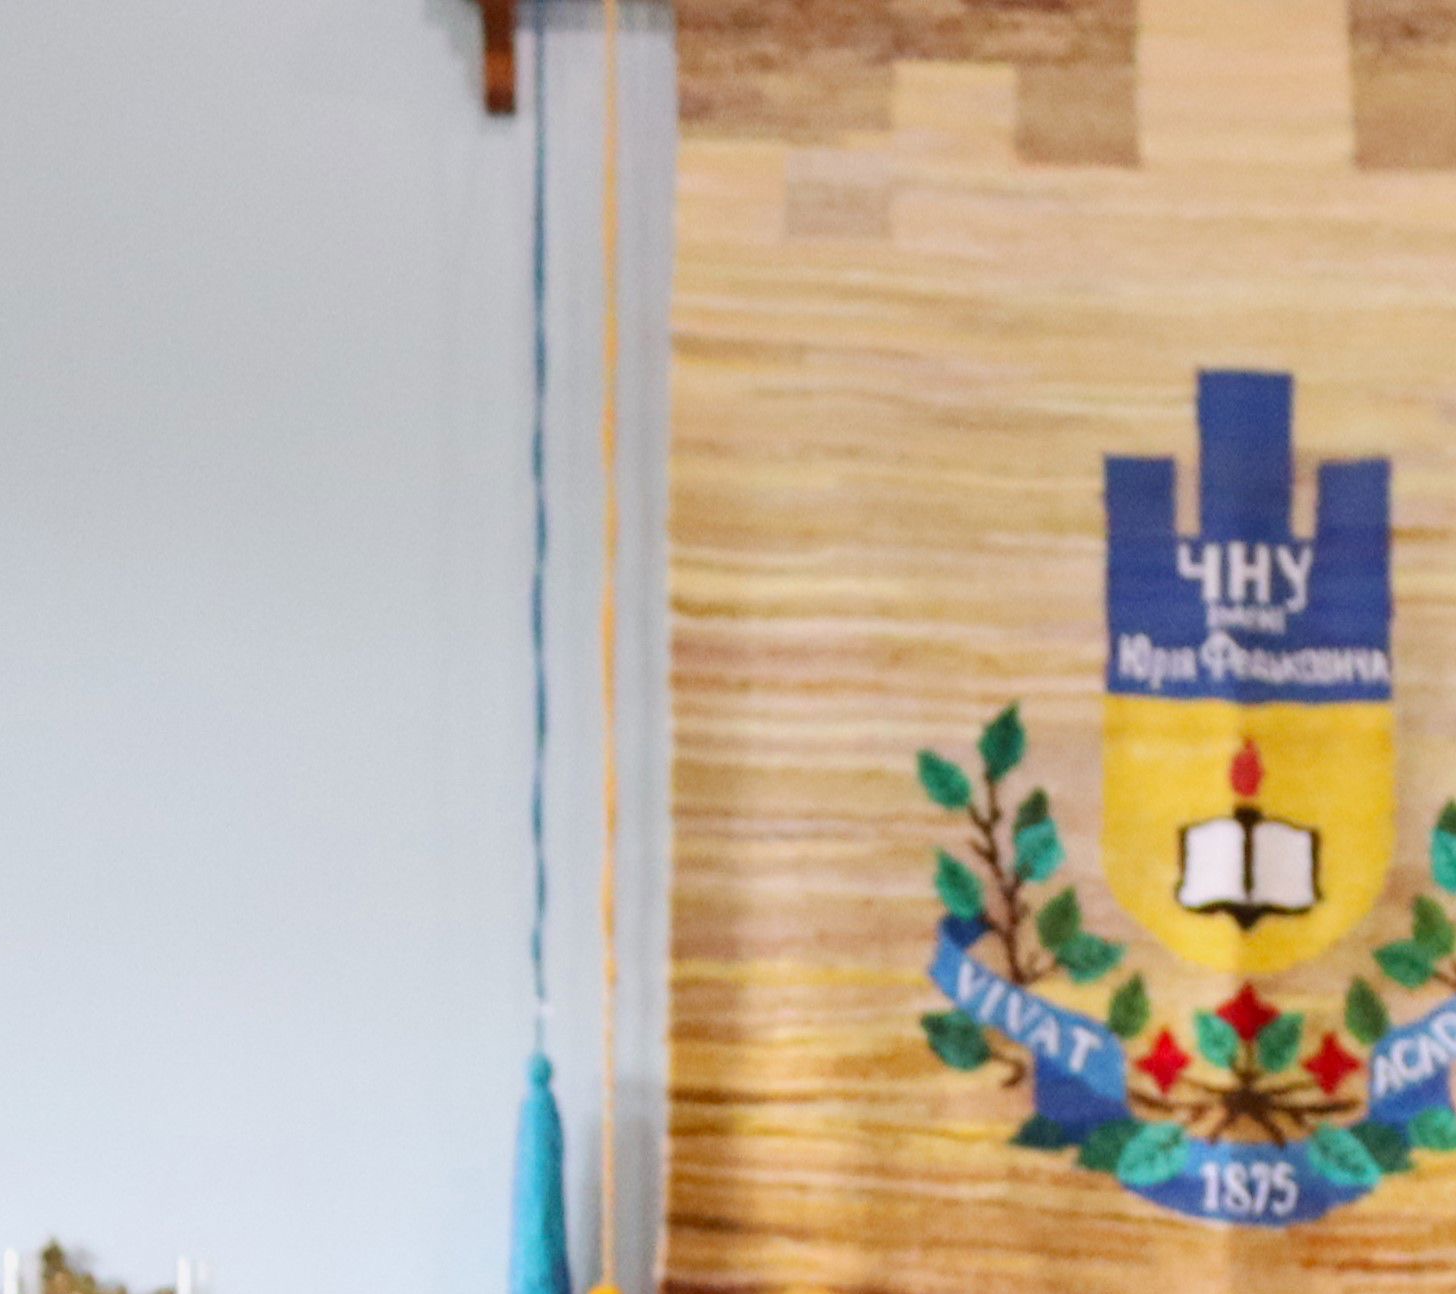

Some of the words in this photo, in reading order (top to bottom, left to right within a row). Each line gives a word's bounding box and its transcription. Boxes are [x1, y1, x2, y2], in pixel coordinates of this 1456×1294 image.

[1176, 541, 1313, 614] ЧНУ
[956, 961, 1102, 1074] VIVAT
[1201, 1161, 1298, 1216] 1875
